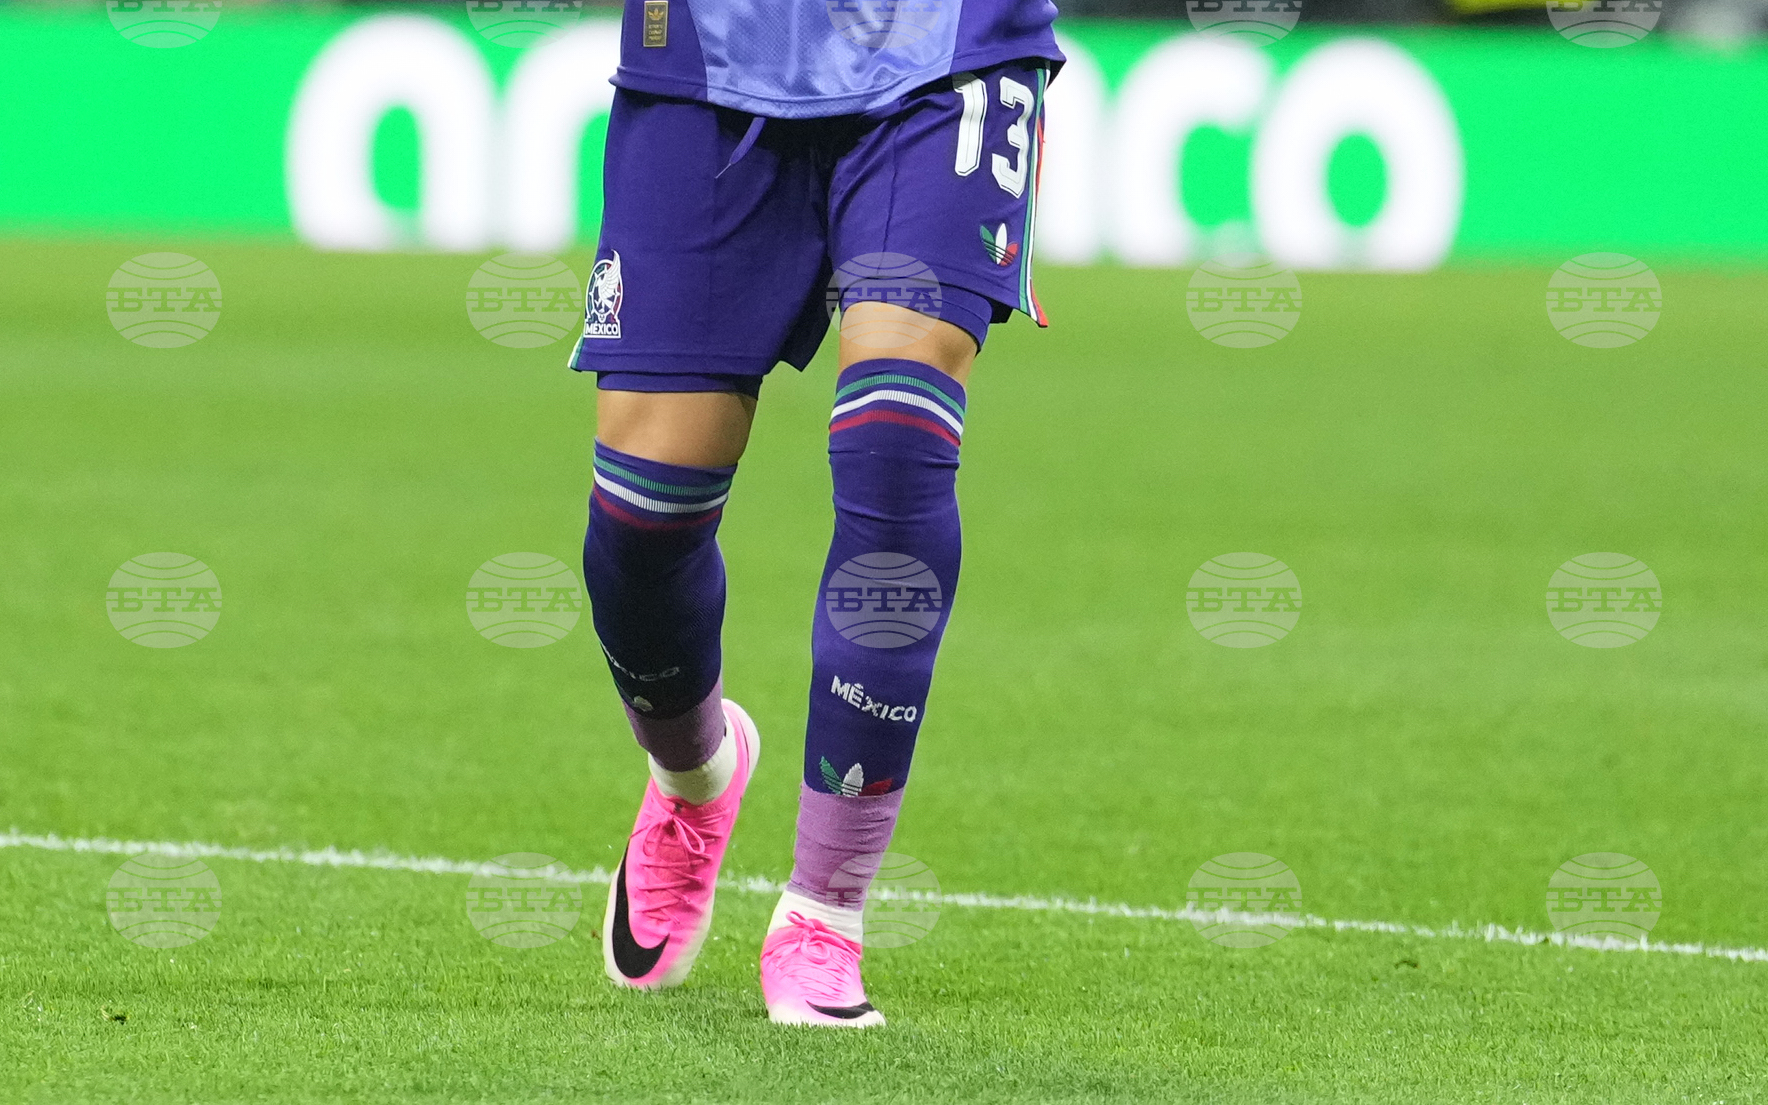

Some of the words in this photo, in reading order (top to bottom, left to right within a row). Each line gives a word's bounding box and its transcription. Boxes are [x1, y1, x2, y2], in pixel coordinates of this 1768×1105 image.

[286, 13, 1466, 269] arco
[952, 72, 1035, 199] 13
[585, 321, 619, 335] MÉXICO
[830, 675, 917, 723] MÉXICO
